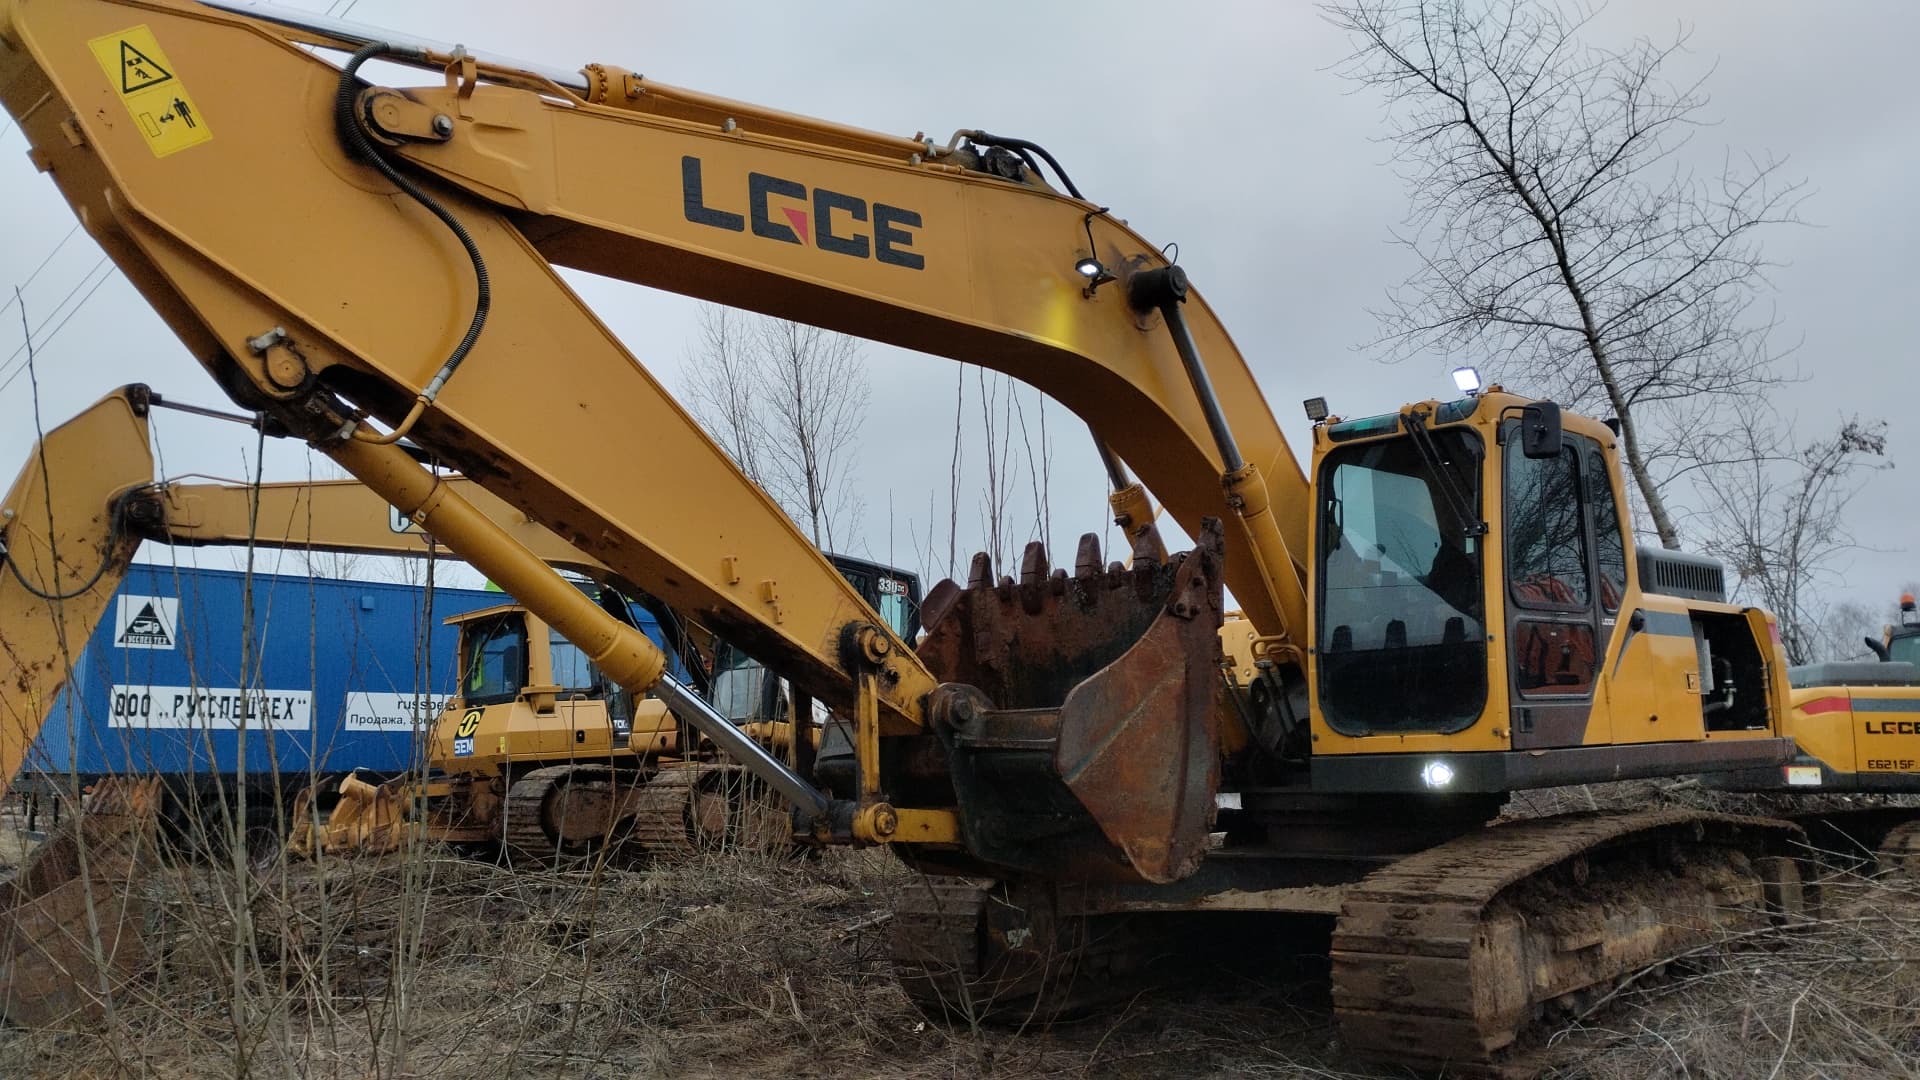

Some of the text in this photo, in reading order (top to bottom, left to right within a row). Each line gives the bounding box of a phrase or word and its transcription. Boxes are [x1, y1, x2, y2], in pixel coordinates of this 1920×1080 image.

[682, 155, 925, 271] LGCE
[115, 693, 150, 717] ООО
[350, 714, 406, 726] Продажа,
[455, 739, 473, 754] SEM
